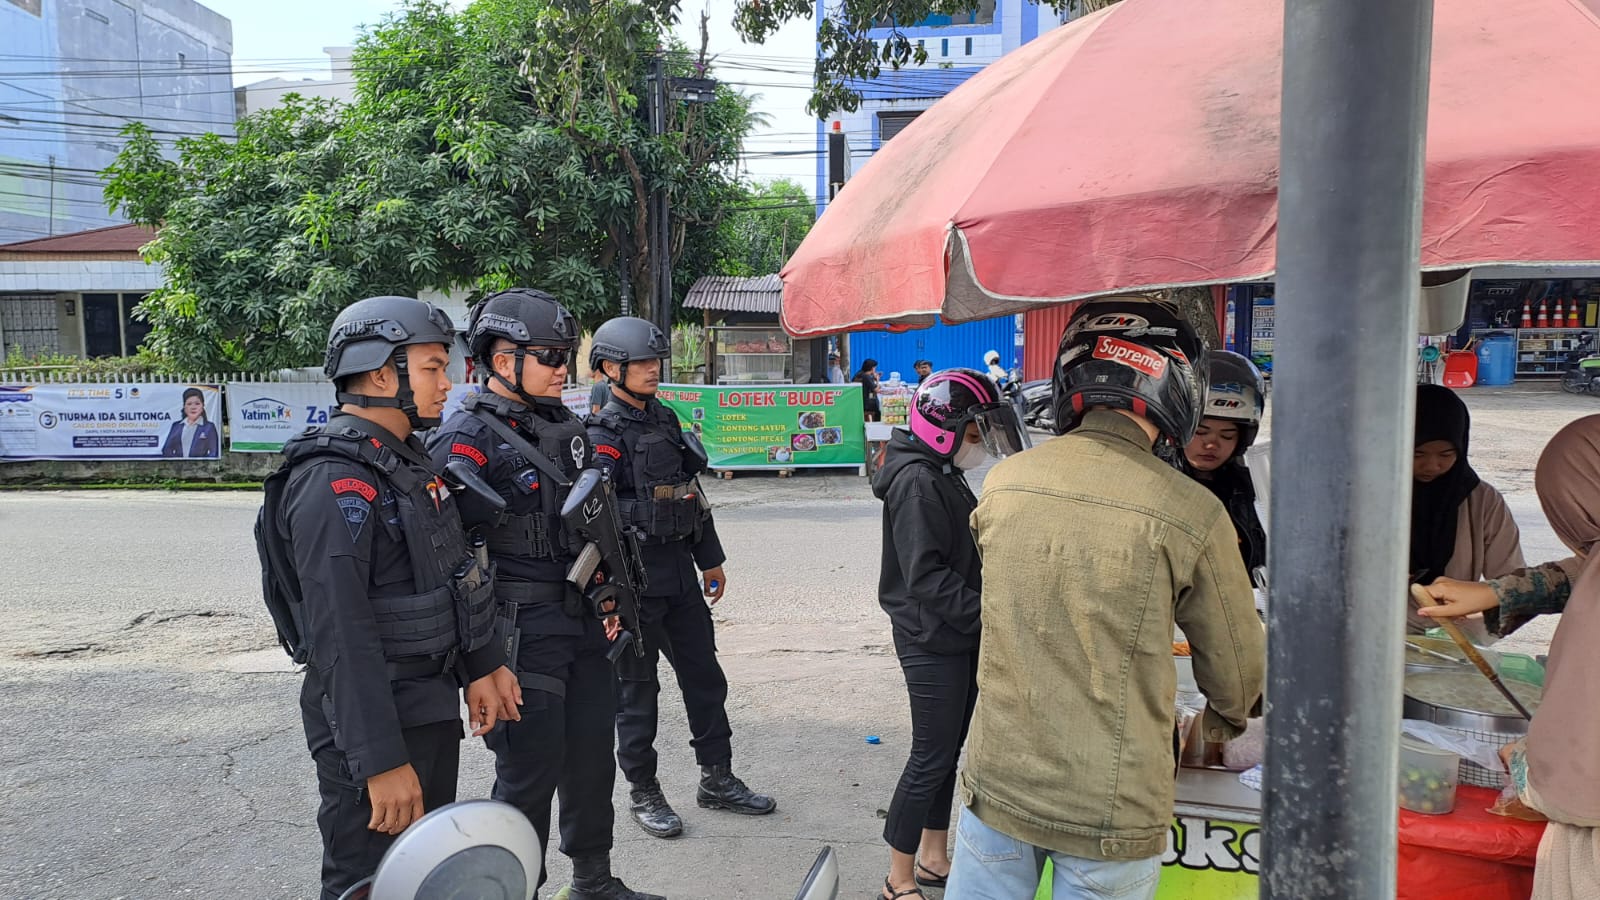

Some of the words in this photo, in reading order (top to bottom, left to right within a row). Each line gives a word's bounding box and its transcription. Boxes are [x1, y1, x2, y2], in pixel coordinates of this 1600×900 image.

[1096, 316, 1137, 326] GM
[1100, 338, 1161, 371] Supreme
[115, 388, 123, 399] 5
[719, 391, 776, 408] LOTEK
[780, 390, 843, 406] "BUDE"
[1213, 399, 1240, 408] GM
[58, 412, 96, 421] TIURMA
[99, 412, 116, 421] IDA
[119, 412, 171, 421] SILITONGA
[241, 409, 270, 420] Yatim
[306, 405, 332, 424] Za
[333, 480, 375, 498] PELOPOR
